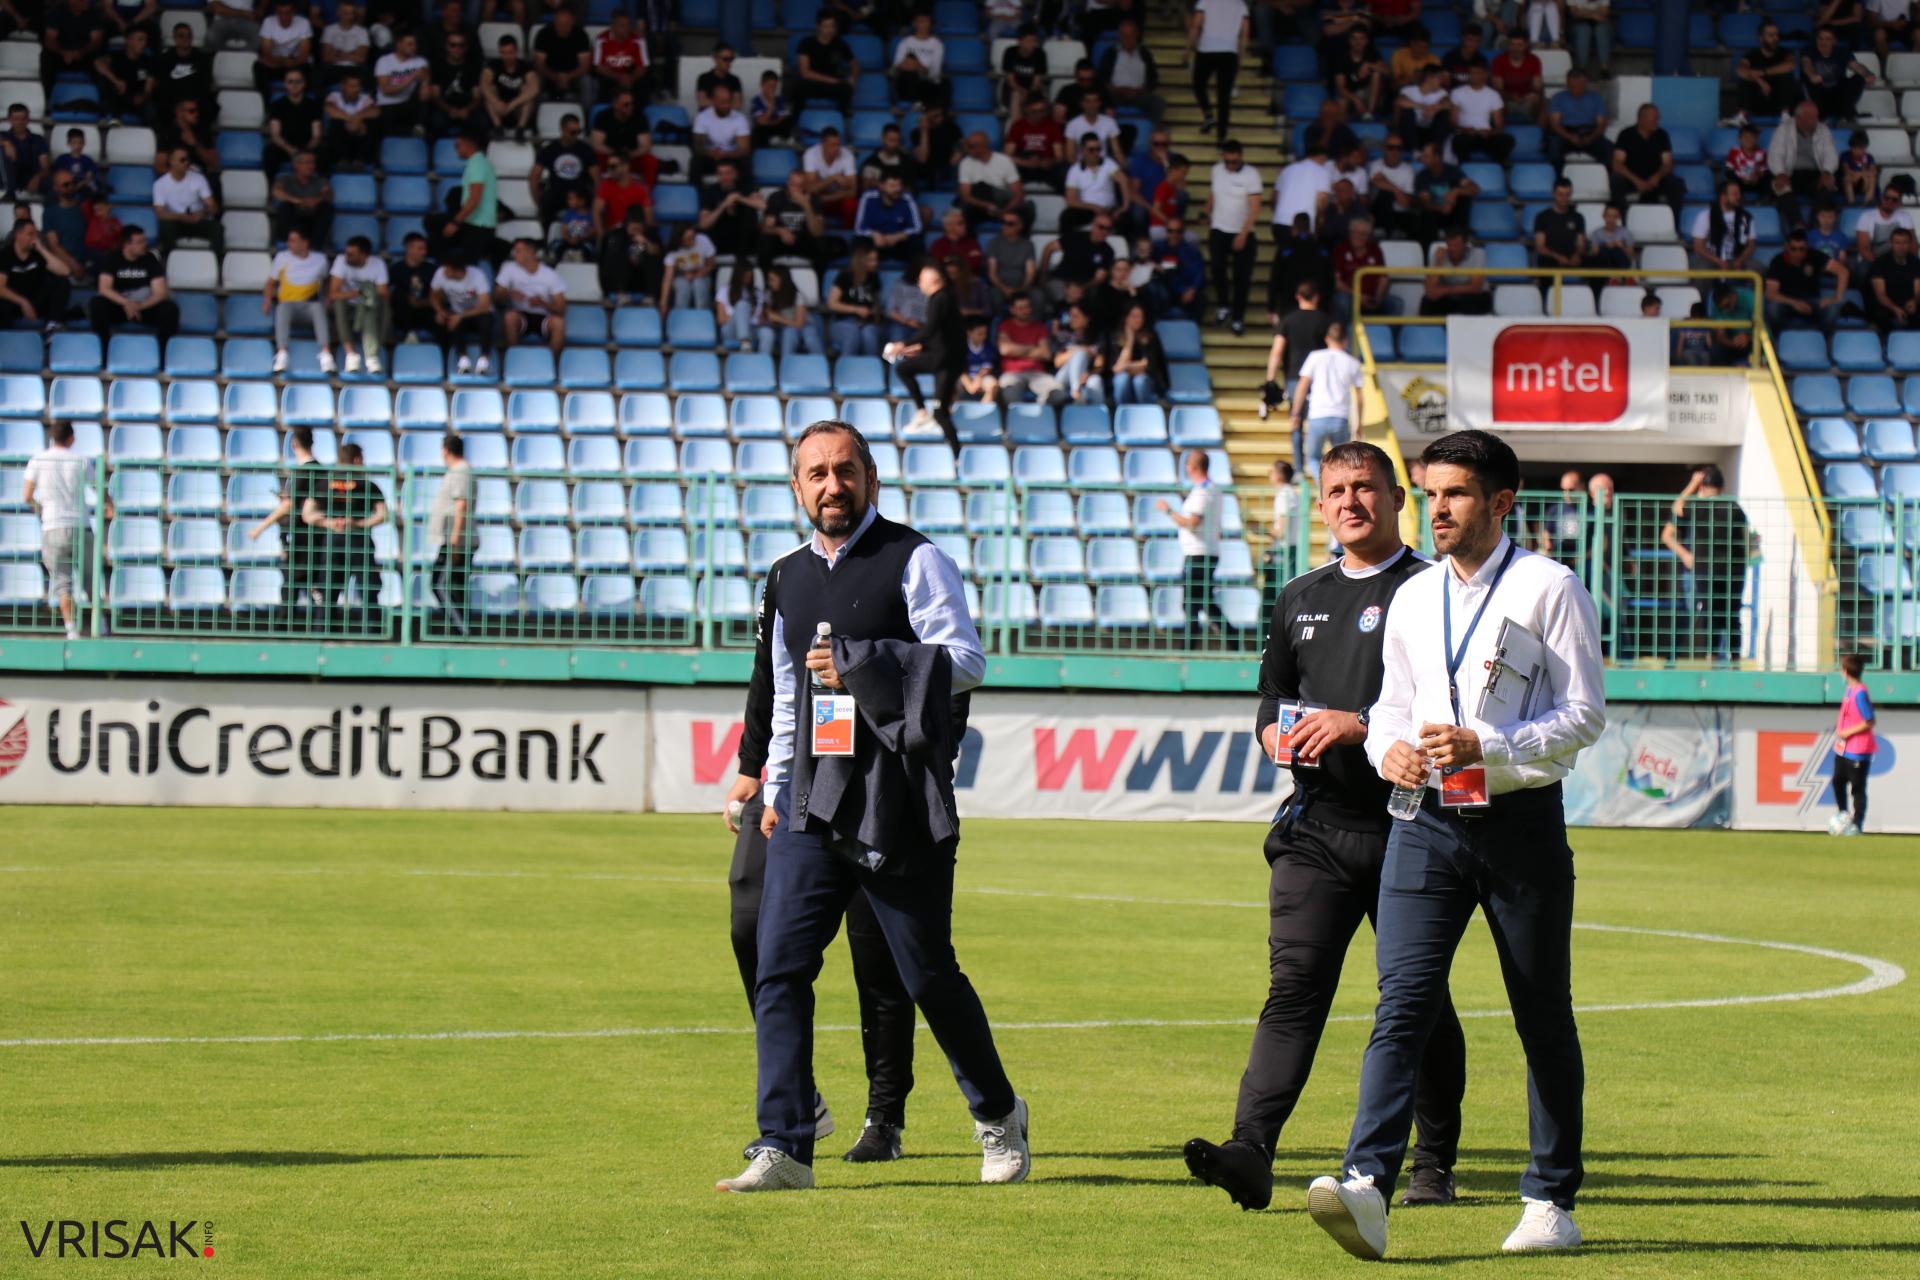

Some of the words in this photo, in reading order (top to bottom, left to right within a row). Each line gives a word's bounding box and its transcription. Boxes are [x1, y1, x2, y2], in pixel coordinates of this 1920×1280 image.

[1505, 352, 1613, 393] m:tel
[1296, 613, 1330, 622] KELME
[46, 700, 404, 778] UniCredit
[420, 715, 607, 784] Bank
